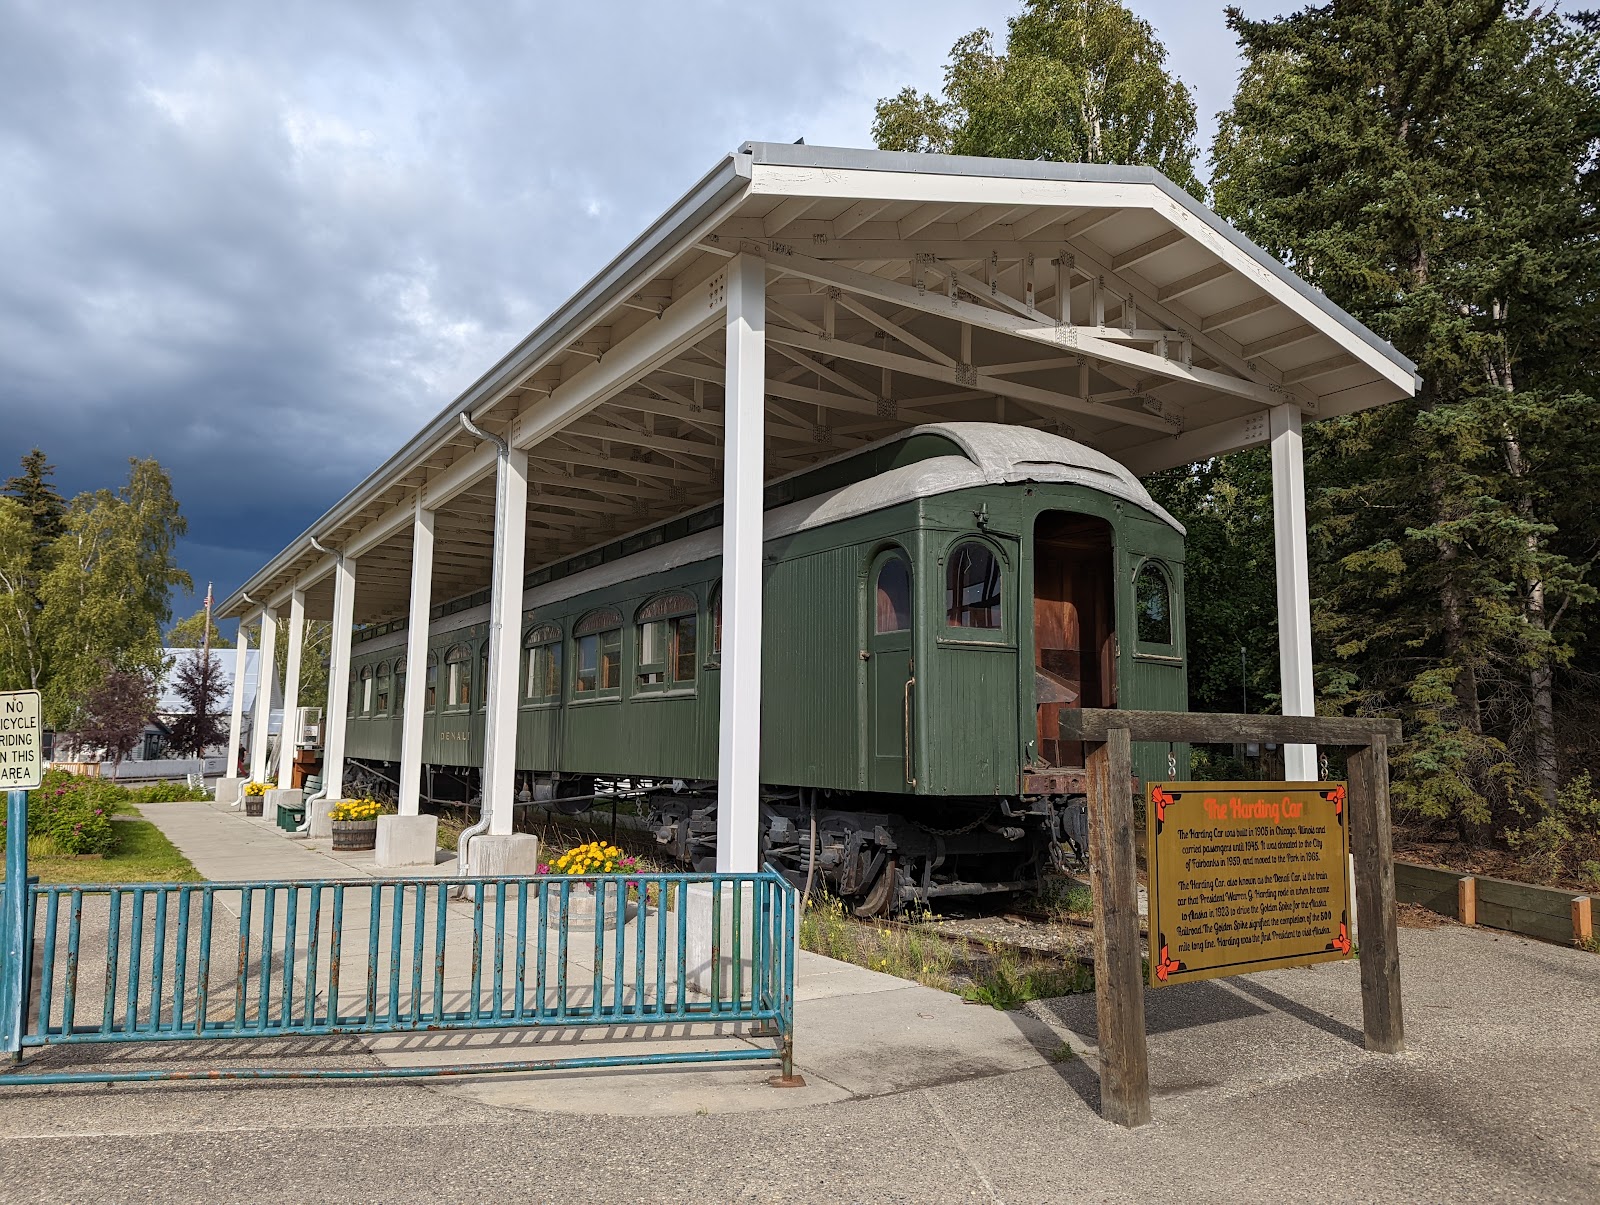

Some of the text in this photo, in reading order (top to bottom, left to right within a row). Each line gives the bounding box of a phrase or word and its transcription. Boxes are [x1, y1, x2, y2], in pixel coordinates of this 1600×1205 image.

[6, 701, 23, 713] NO
[0, 716, 36, 730] ICYCLE
[440, 731, 470, 740] DENALI
[12, 750, 34, 762] THIS
[1, 767, 31, 780] AREA
[1204, 797, 1302, 825] The Harding Car
[1178, 829, 1188, 839] The
[1189, 828, 1212, 841] Harding
[1214, 828, 1223, 838] Car
[1237, 828, 1248, 837] built
[1249, 828, 1254, 836] in
[1270, 827, 1274, 836] in
[1316, 826, 1326, 834] and
[1182, 845, 1201, 854] carried
[1203, 844, 1232, 856] passengers
[1233, 842, 1244, 852] until
[1261, 840, 1266, 850] It
[1277, 840, 1298, 849] donated
[1312, 838, 1322, 850] City
[1186, 859, 1191, 872] of
[1192, 858, 1220, 868] Fairbanks
[1220, 858, 1226, 866] in
[1243, 856, 1253, 865] and
[1254, 856, 1271, 864] moved
[1286, 853, 1300, 862] Park
[1300, 852, 1305, 861] in
[1178, 881, 1189, 890] The
[1190, 880, 1214, 891] Harding
[1227, 878, 1238, 887] also
[1238, 877, 1256, 885] known
[1273, 873, 1290, 883] Denali
[1302, 872, 1306, 881] is
[1316, 871, 1328, 880] train
[1188, 896, 1198, 905] that
[1200, 894, 1225, 904] President
[1225, 892, 1247, 901] Warren
[1255, 889, 1277, 900] Harding
[1277, 888, 1288, 897] rode
[1290, 887, 1295, 895] in
[1295, 886, 1309, 895] when
[1188, 910, 1208, 922] Alaska
[1209, 909, 1214, 918] in
[1215, 906, 1229, 917] 1923
[1236, 906, 1250, 914] drive
[1250, 906, 1258, 914] the
[1260, 903, 1278, 915] Golden
[1278, 901, 1292, 912] Spike
[1292, 900, 1300, 913] for
[1309, 899, 1327, 910] Alaska
[1203, 923, 1212, 933] The
[1214, 922, 1233, 935] Golden
[1234, 920, 1248, 932] Spike
[1249, 917, 1270, 930] signified
[1271, 917, 1279, 926] the
[1280, 914, 1306, 926] completion
[1306, 912, 1311, 925] of
[1320, 911, 1331, 921] 500
[1178, 942, 1190, 952] mile
[1191, 941, 1204, 952] long
[1216, 936, 1240, 947] Harding
[1251, 934, 1260, 942] the
[1261, 931, 1271, 944] first
[1272, 929, 1295, 940] President
[1302, 928, 1311, 936] visit
